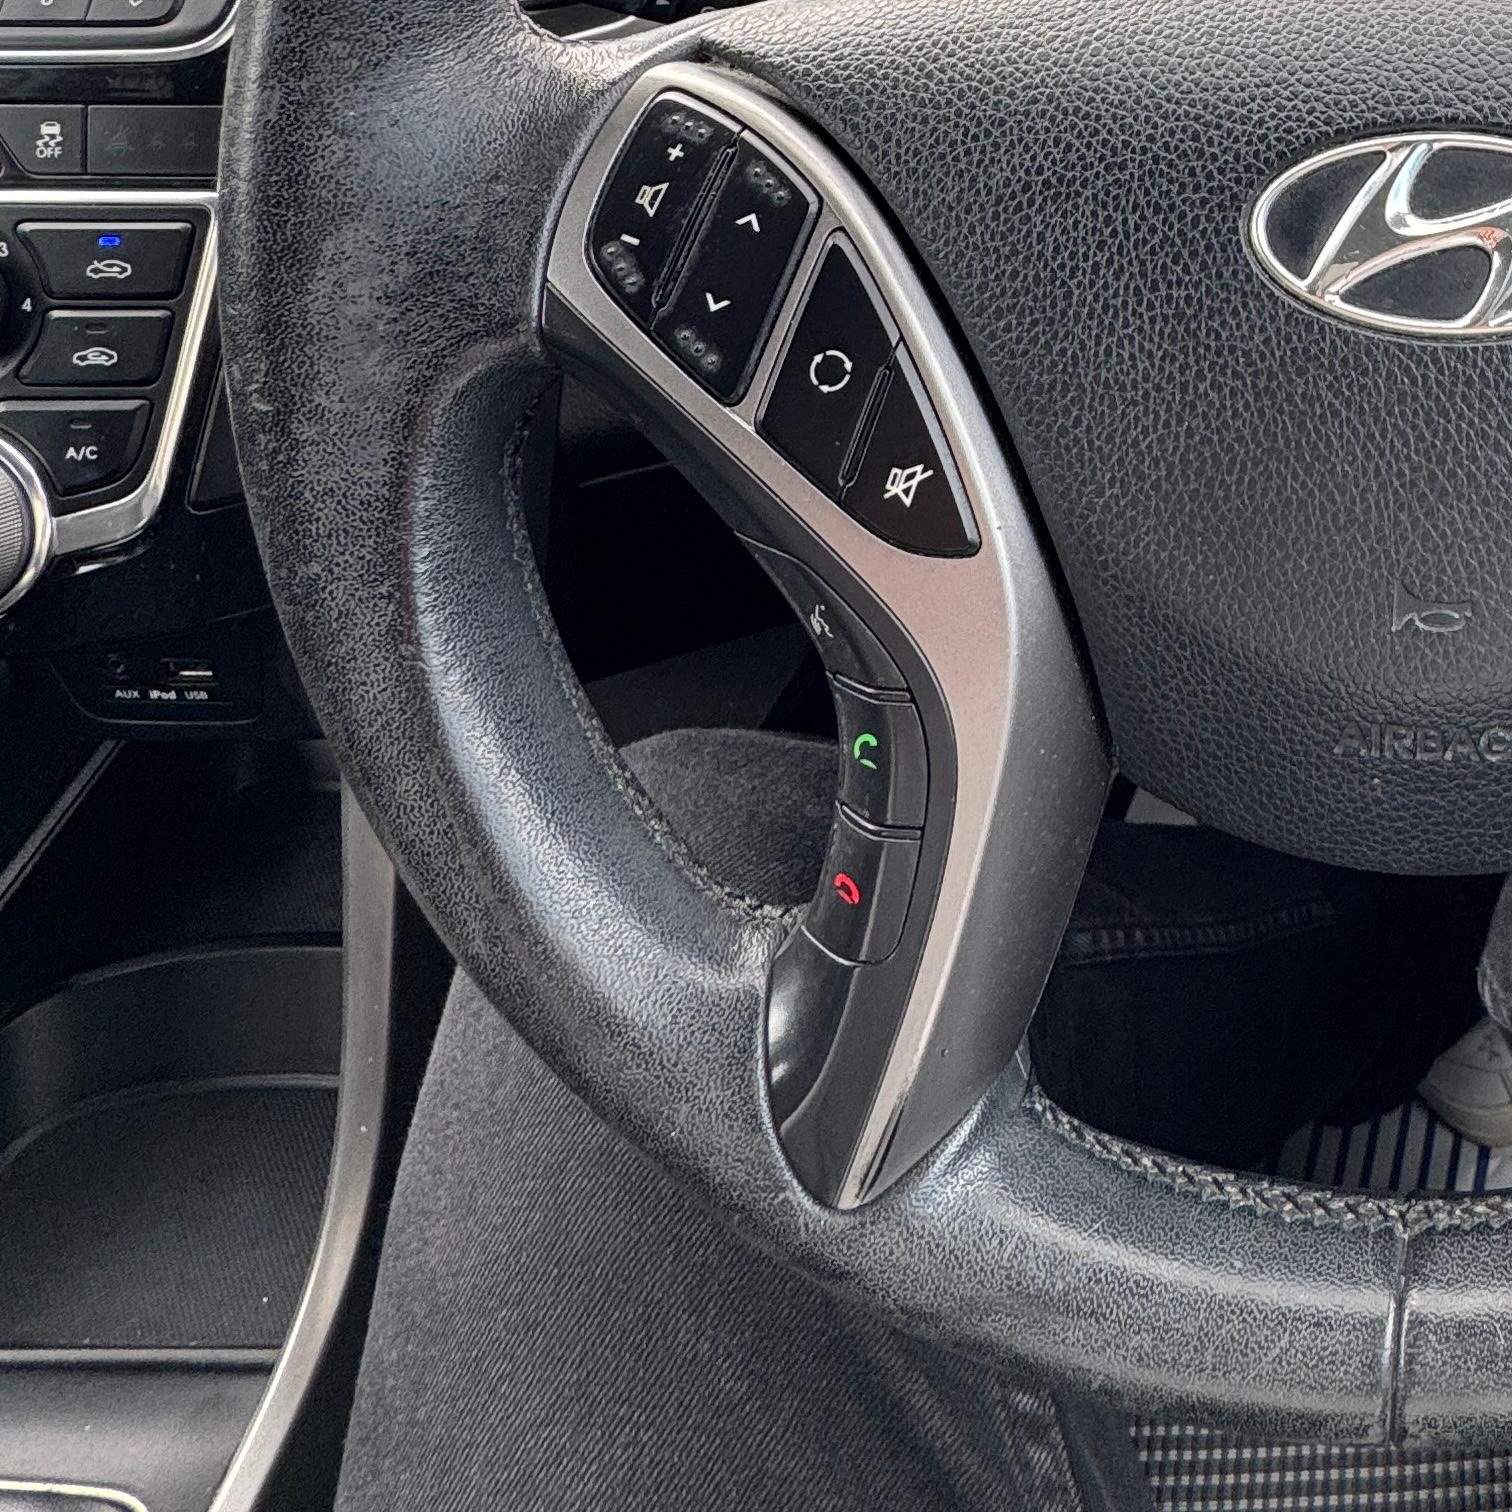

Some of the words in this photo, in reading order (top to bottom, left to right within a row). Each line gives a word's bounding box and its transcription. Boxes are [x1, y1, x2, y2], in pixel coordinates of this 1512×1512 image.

[35, 146, 63, 159] OFF
[21, 297, 32, 312] 4
[65, 445, 98, 462] A/C
[115, 689, 140, 699] AUX
[184, 690, 208, 700] USB
